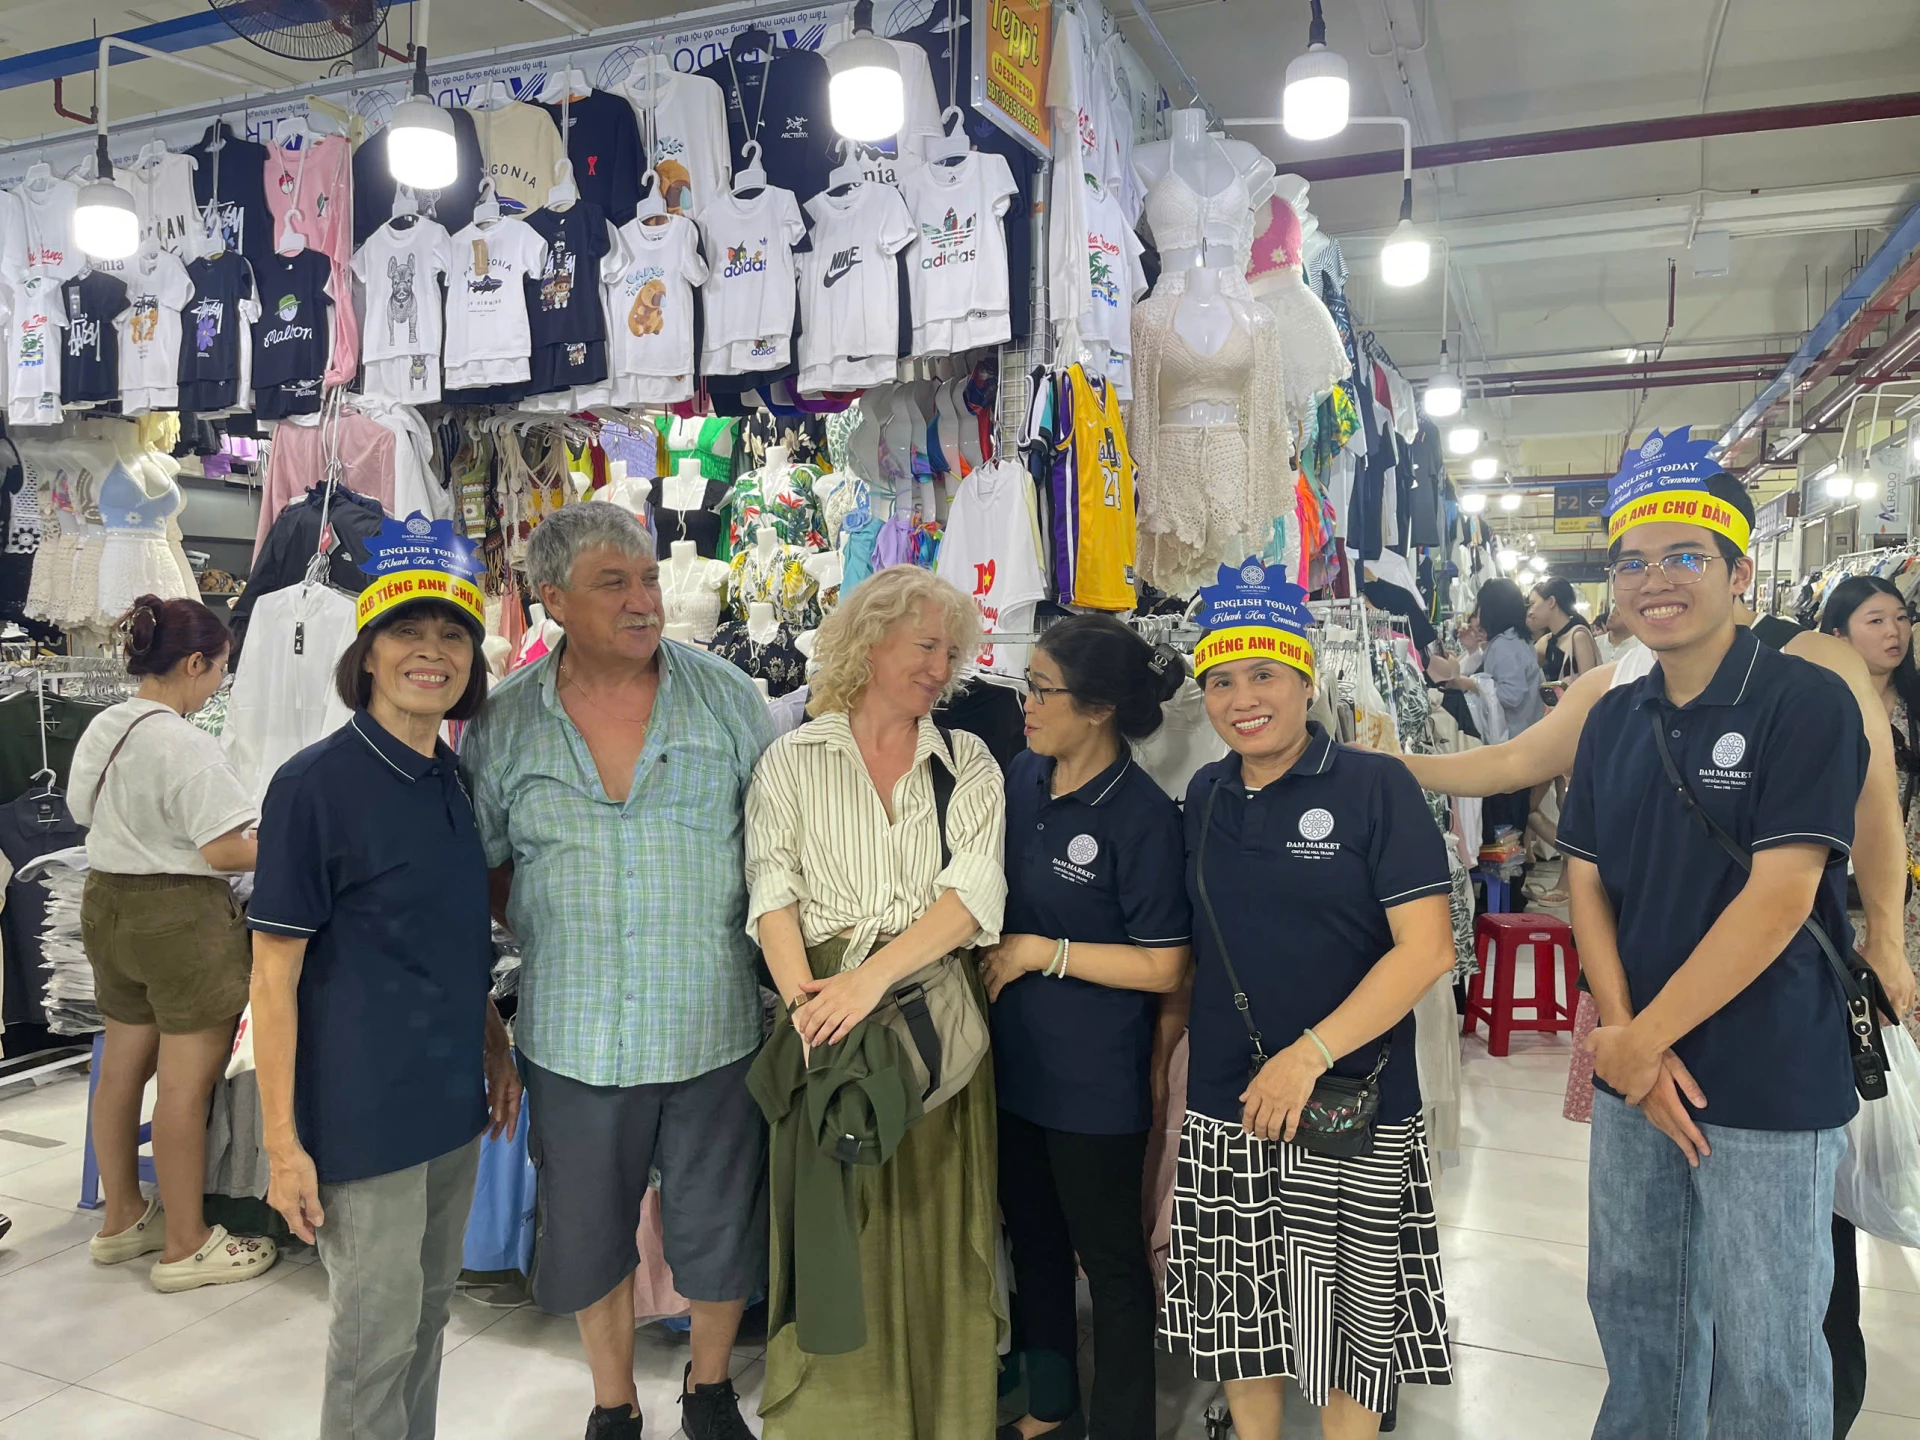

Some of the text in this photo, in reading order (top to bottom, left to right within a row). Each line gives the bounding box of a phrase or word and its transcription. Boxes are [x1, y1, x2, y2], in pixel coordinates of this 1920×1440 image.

[829, 246, 863, 272] NIKE
[921, 249, 976, 270] adidas
[264, 323, 312, 348] Malbon
[1614, 468, 1654, 495] ENGLISH
[1656, 462, 1699, 474] TODAY
[1557, 495, 1579, 510] F2
[1629, 503, 1658, 522] ANH
[1662, 500, 1698, 518] CHỢ
[379, 546, 468, 564] ENGLISH TODAY
[360, 594, 375, 618] CLB
[376, 579, 413, 604] TIẾNG
[418, 578, 447, 592] ANH
[451, 583, 474, 607] CHỢ
[1214, 599, 1298, 615] ENGLISH TODAY
[1195, 648, 1206, 669] CLB
[1207, 635, 1244, 658] TIẾNG
[1248, 636, 1276, 652] ANH
[1279, 641, 1302, 663] CHỢ
[1716, 770, 1753, 779] MARKET
[1306, 842, 1341, 850] MARKET
[1052, 857, 1067, 867] DAM
[1066, 863, 1096, 880] MARKET
